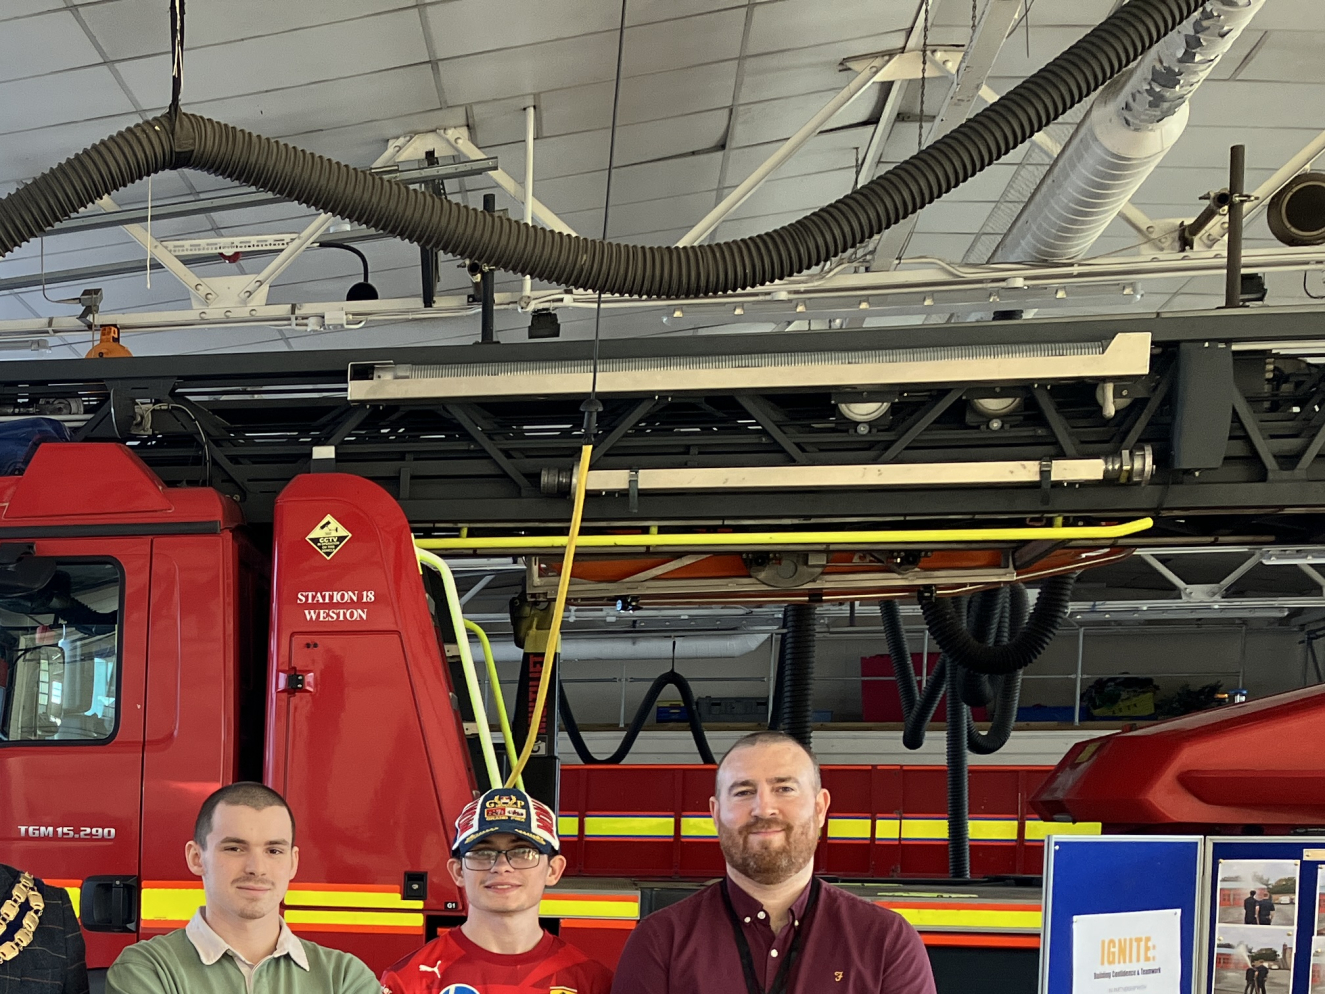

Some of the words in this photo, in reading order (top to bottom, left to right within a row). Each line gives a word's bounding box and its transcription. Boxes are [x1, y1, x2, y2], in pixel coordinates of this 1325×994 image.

[297, 591, 358, 604] STATION
[362, 591, 375, 603] 18
[304, 609, 368, 621] WESTON
[18, 826, 54, 838] TGM
[56, 827, 116, 839] 15.290
[1100, 936, 1157, 966] IGNITE:
[1112, 969, 1136, 978] Confidence
[1141, 967, 1161, 975] Teamwork
